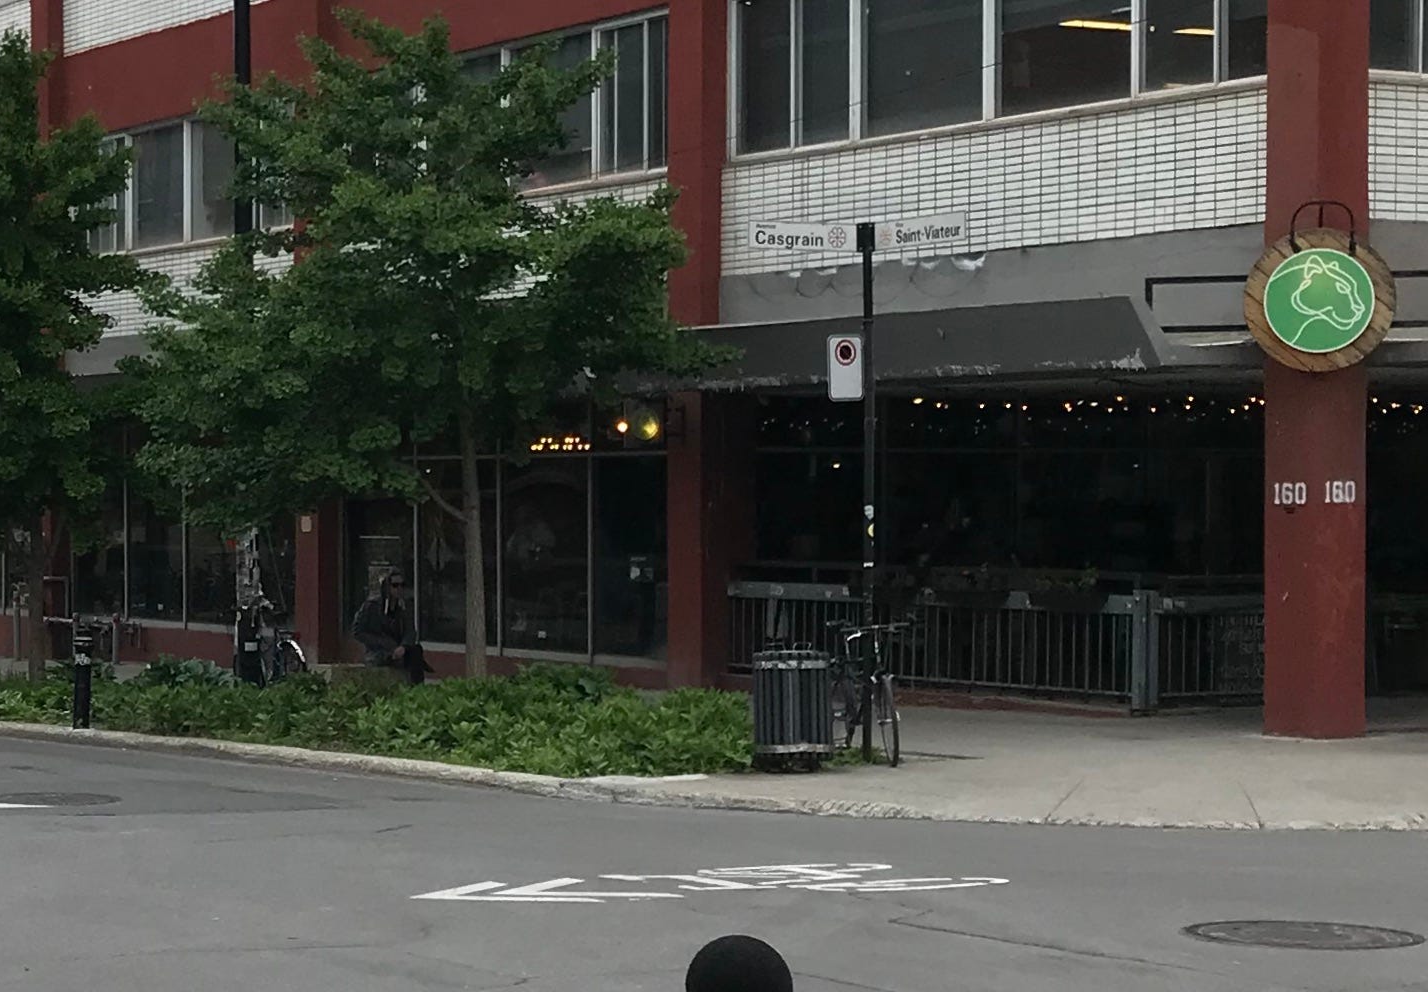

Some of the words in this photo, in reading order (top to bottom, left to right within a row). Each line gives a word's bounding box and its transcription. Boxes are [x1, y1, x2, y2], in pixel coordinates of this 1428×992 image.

[755, 230, 824, 250] Casgrain
[895, 225, 961, 244] Saint-Viateur
[1274, 482, 1307, 505] 160
[1324, 481, 1356, 503] 160
